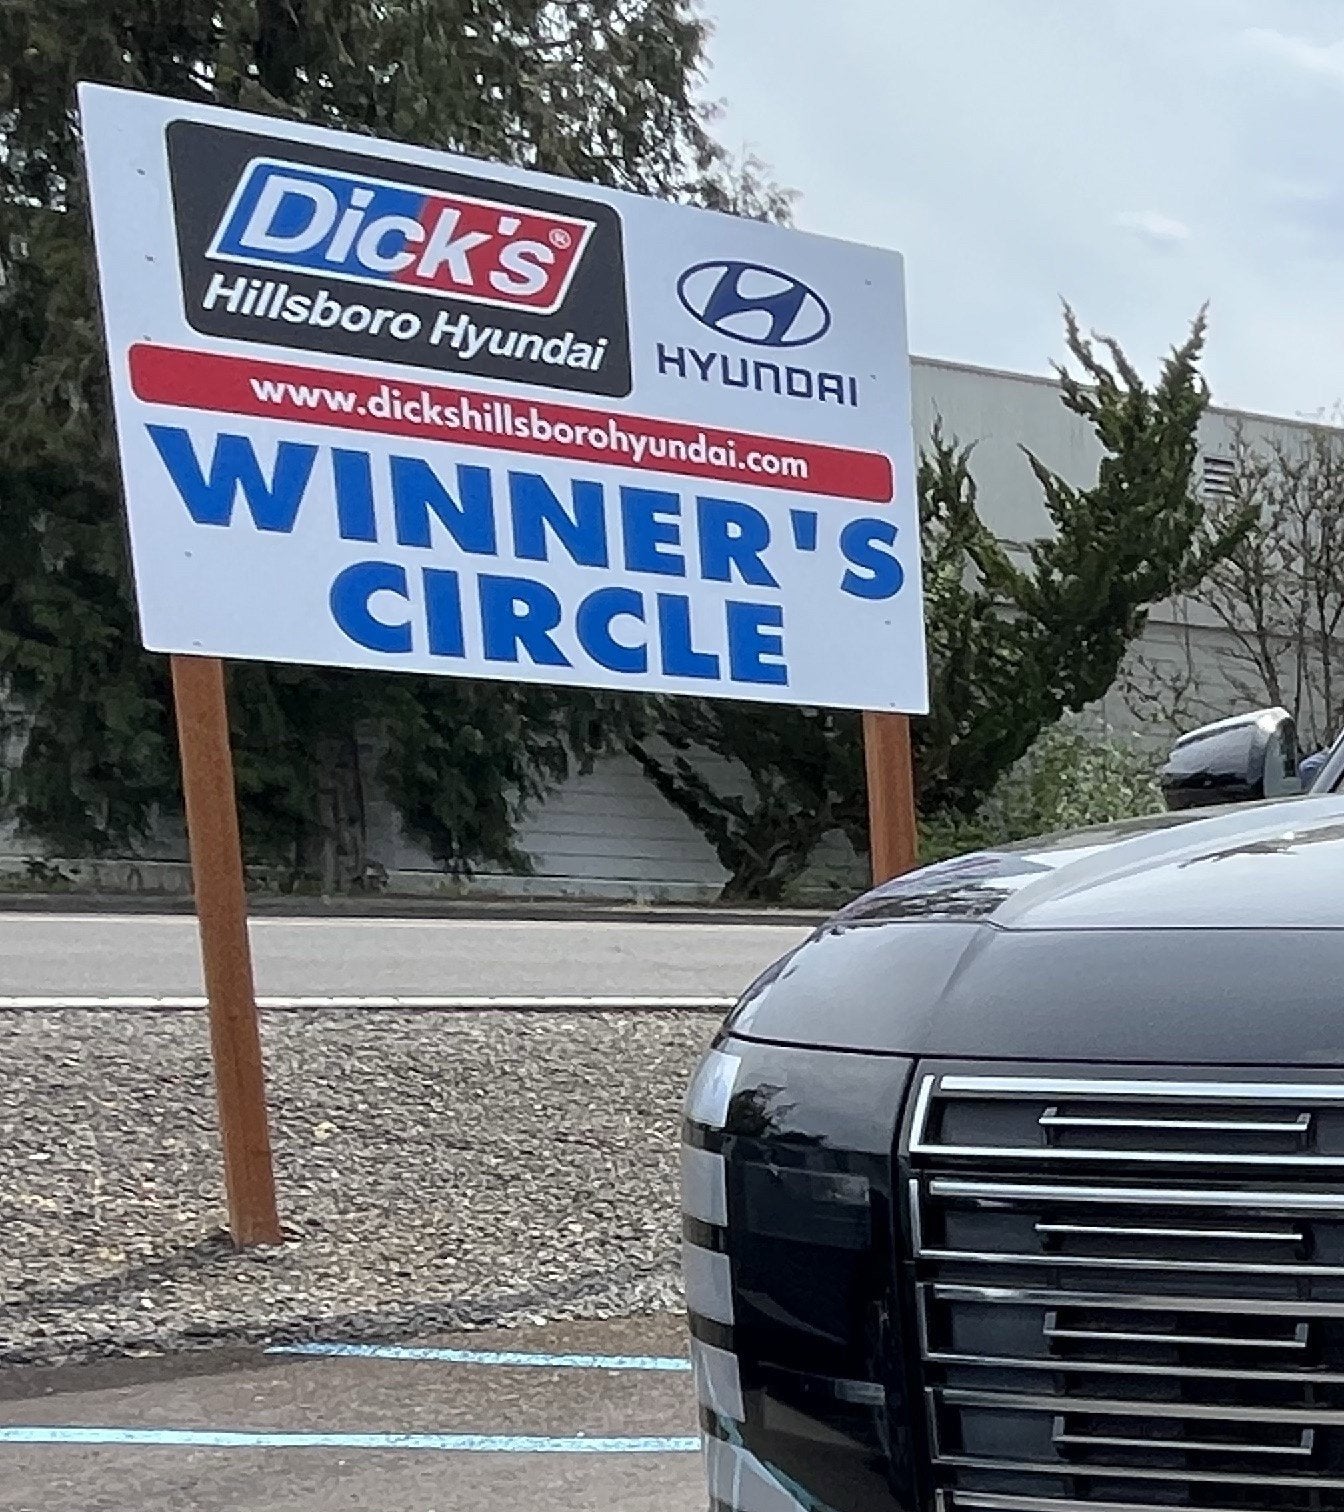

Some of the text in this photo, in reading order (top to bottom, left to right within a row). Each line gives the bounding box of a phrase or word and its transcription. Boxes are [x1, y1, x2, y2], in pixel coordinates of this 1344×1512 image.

[239, 174, 557, 299] Dick's
[203, 273, 608, 372] Hillsboro Hyundai
[657, 344, 858, 407] HYUNDAI
[250, 379, 810, 481] www.dickshillsborohyundai.com
[145, 424, 905, 600] WINNER'S
[329, 560, 789, 687] CIRCLE
